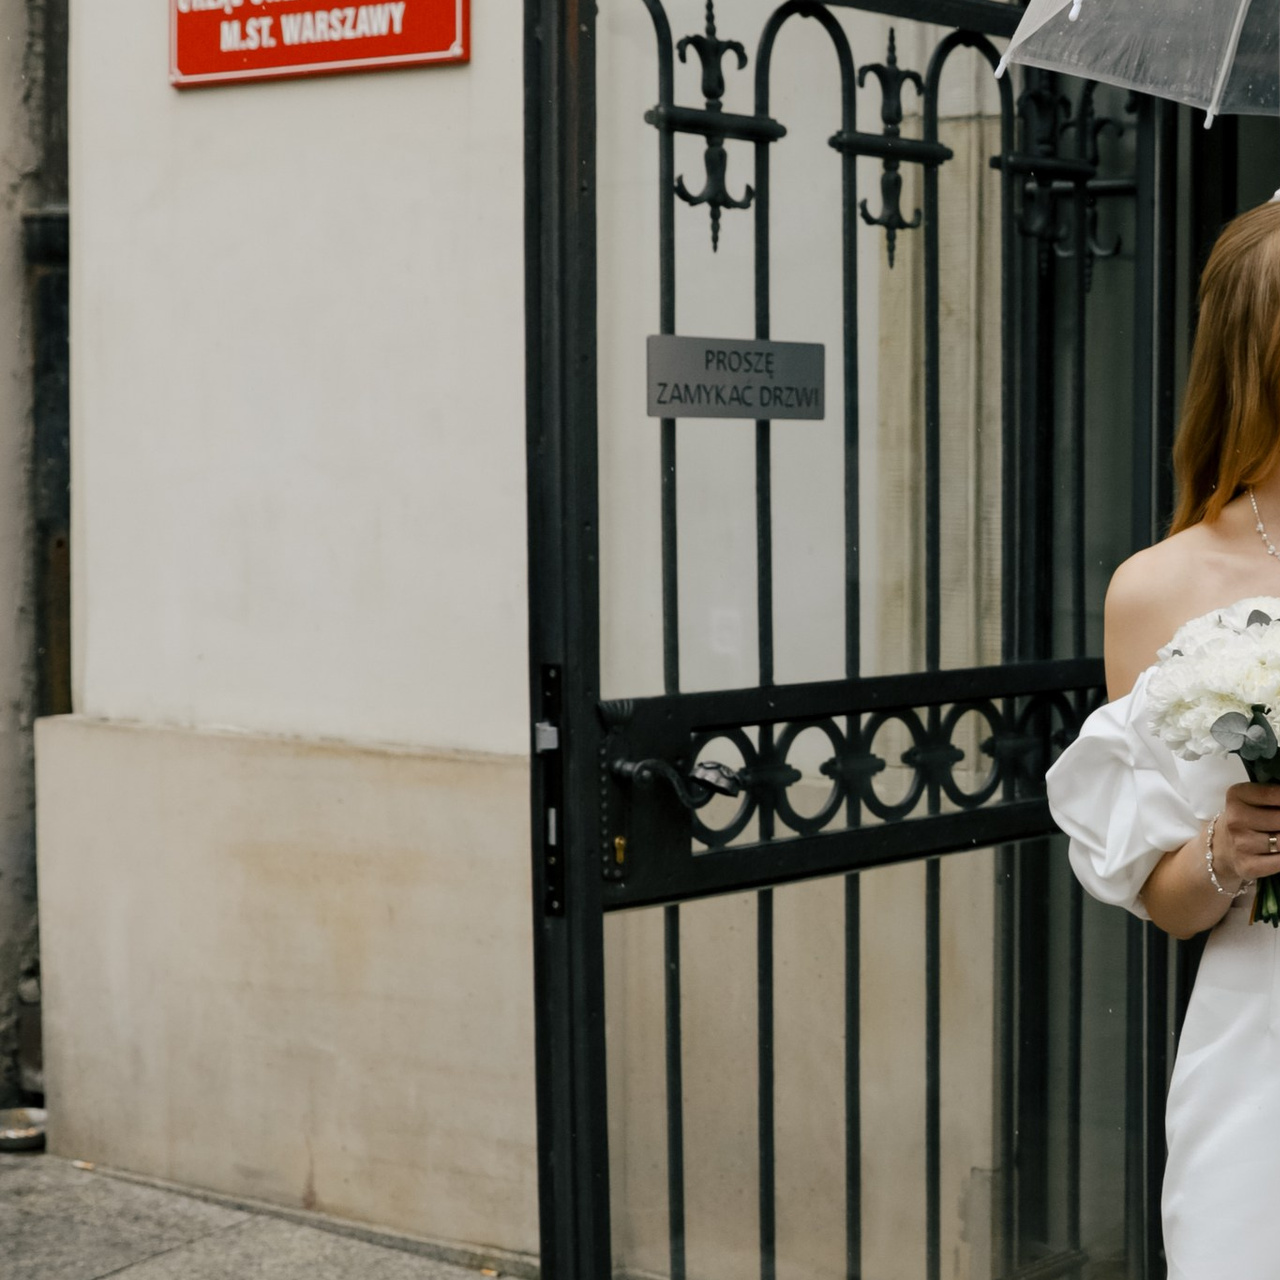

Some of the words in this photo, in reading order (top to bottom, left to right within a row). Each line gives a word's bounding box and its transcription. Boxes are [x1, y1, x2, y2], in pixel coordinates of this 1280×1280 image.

[220, 16, 277, 52] M.ST.
[280, 1, 406, 45] WARSZAWY
[704, 349, 775, 379] PROSZĘ
[759, 385, 819, 408] DRZWI
